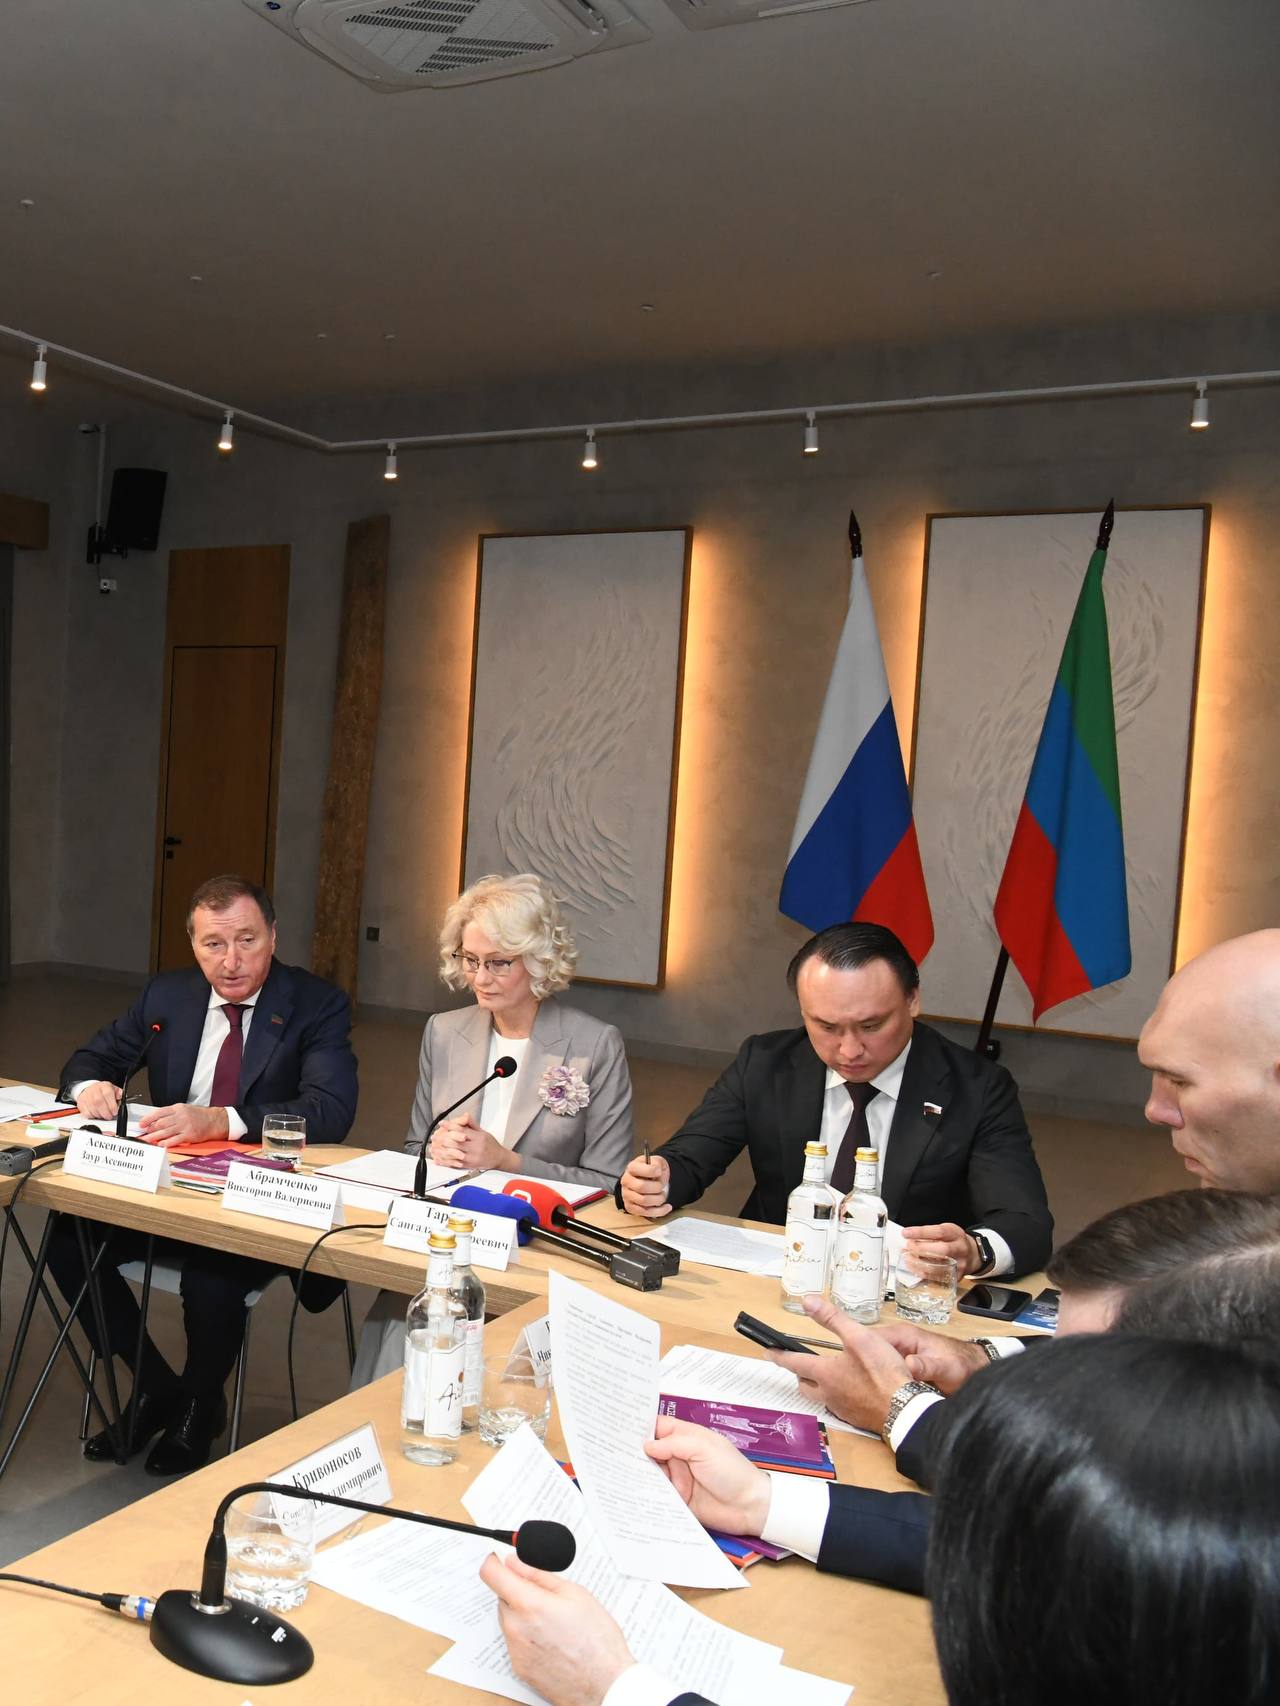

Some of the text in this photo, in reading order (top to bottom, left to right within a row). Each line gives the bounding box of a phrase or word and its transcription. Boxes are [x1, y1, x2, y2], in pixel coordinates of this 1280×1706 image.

[86, 1137, 145, 1157] Аскендеров
[246, 1169, 318, 1193] Абрамченко
[227, 1181, 272, 1198] Виктория
[274, 1190, 332, 1210] Валериевна
[389, 1216, 433, 1235] Сангад
[426, 1206, 478, 1227] Тарв
[292, 1446, 362, 1493] Кривоносов
